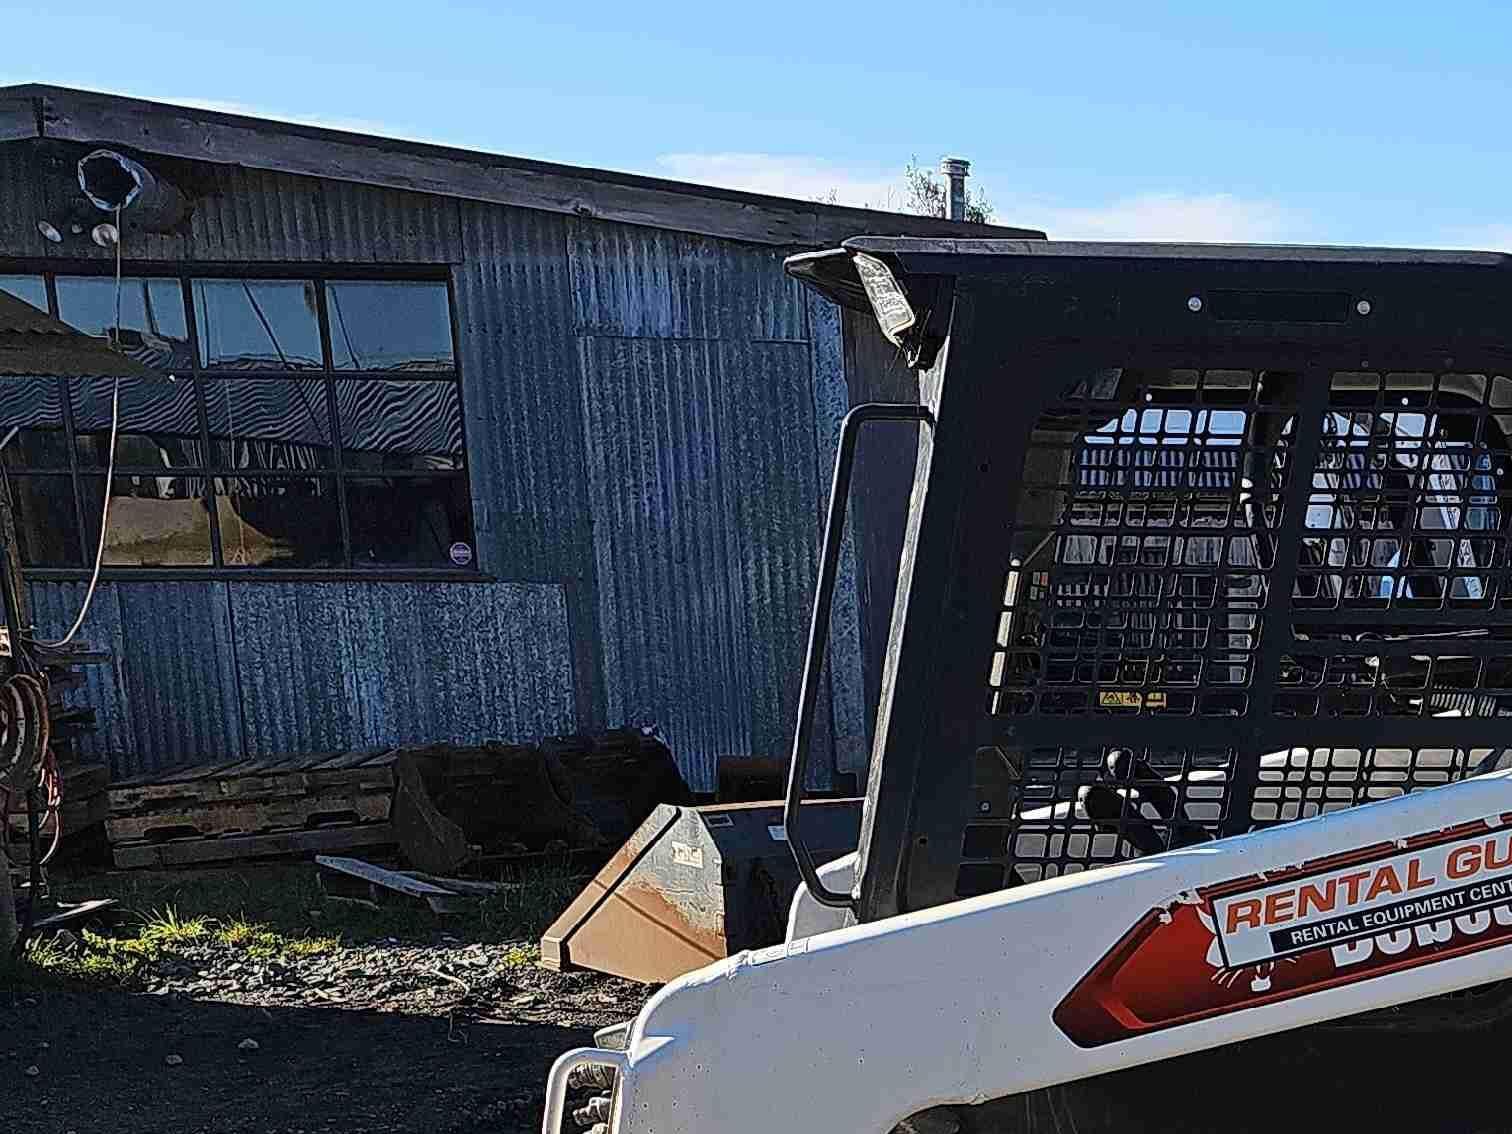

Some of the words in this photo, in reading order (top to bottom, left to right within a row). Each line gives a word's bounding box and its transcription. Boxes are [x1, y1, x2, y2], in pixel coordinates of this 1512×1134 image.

[1225, 858, 1437, 935] RENTAL
[1290, 914, 1360, 946] RENTAL
[1362, 891, 1466, 929] EQUIPMENT
